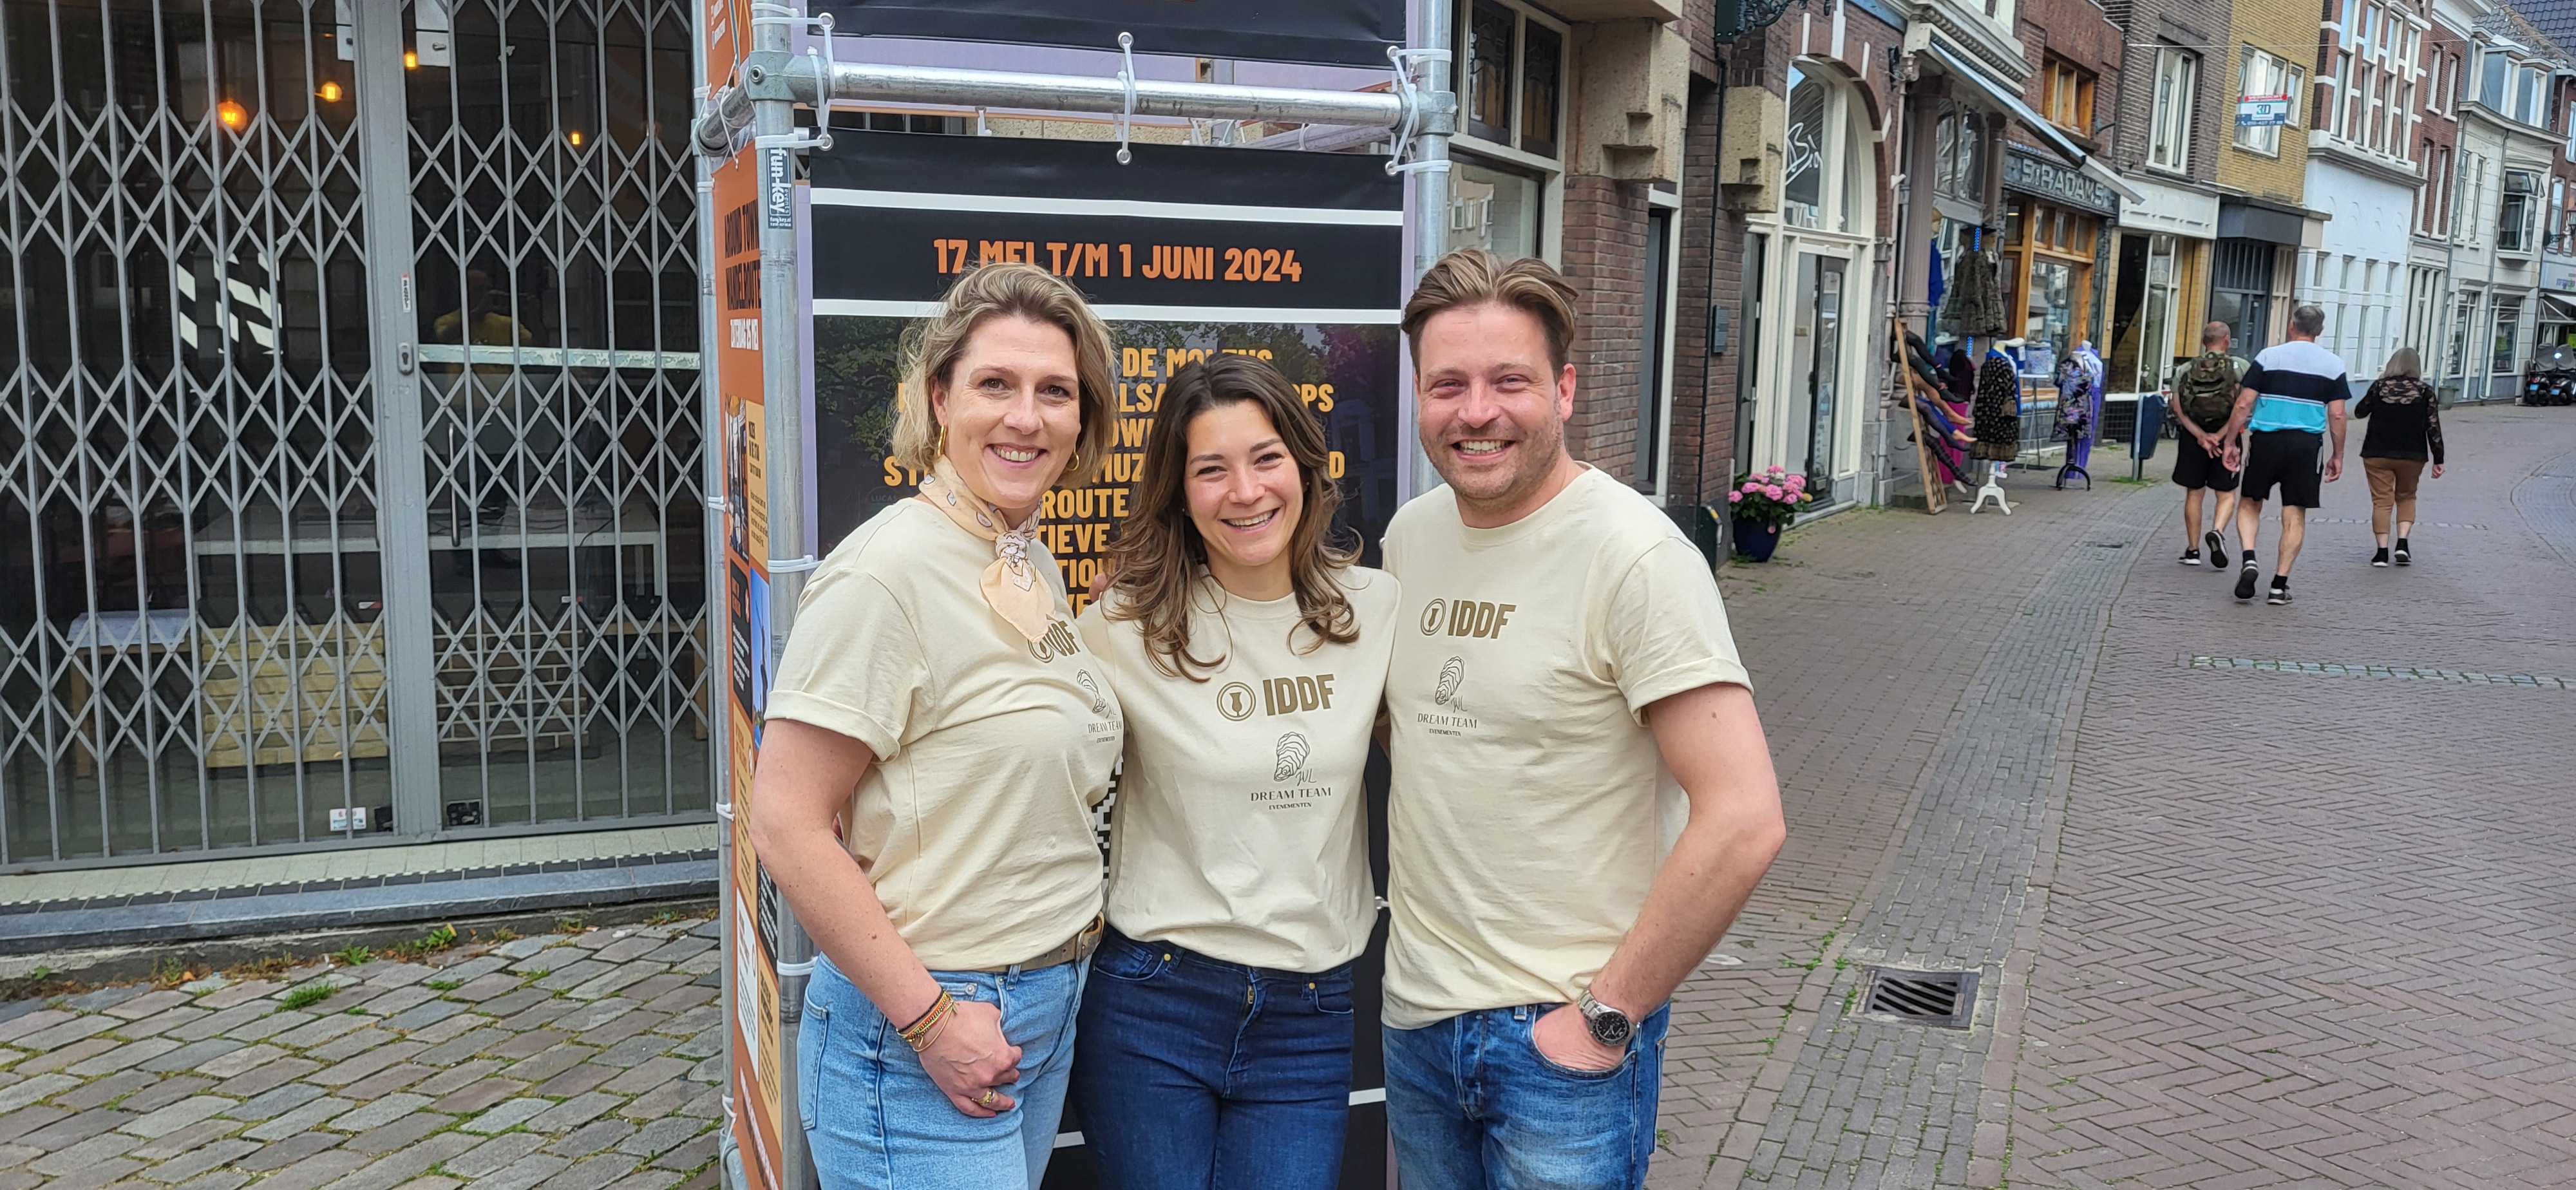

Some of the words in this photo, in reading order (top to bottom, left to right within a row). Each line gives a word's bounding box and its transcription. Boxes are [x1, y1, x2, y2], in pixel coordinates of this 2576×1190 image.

[2257, 104, 2271, 115] 3D
[770, 147, 791, 213] fun-key
[933, 239, 968, 274] 17
[1046, 242, 1108, 278] T/M
[1119, 244, 1132, 278] 1
[1142, 245, 1215, 280] JUNI
[1224, 247, 1302, 282] 2024
[1122, 348, 1157, 377] DE
[1448, 600, 1517, 639] IDDF
[1263, 674, 1334, 716] IDDF
[1088, 722, 1108, 733] DREAM
[1417, 713, 1448, 725] DREAM
[1452, 717, 1477, 728] TEAM
[1251, 789, 1294, 801] DREAM
[1298, 787, 1331, 798] TEAM
